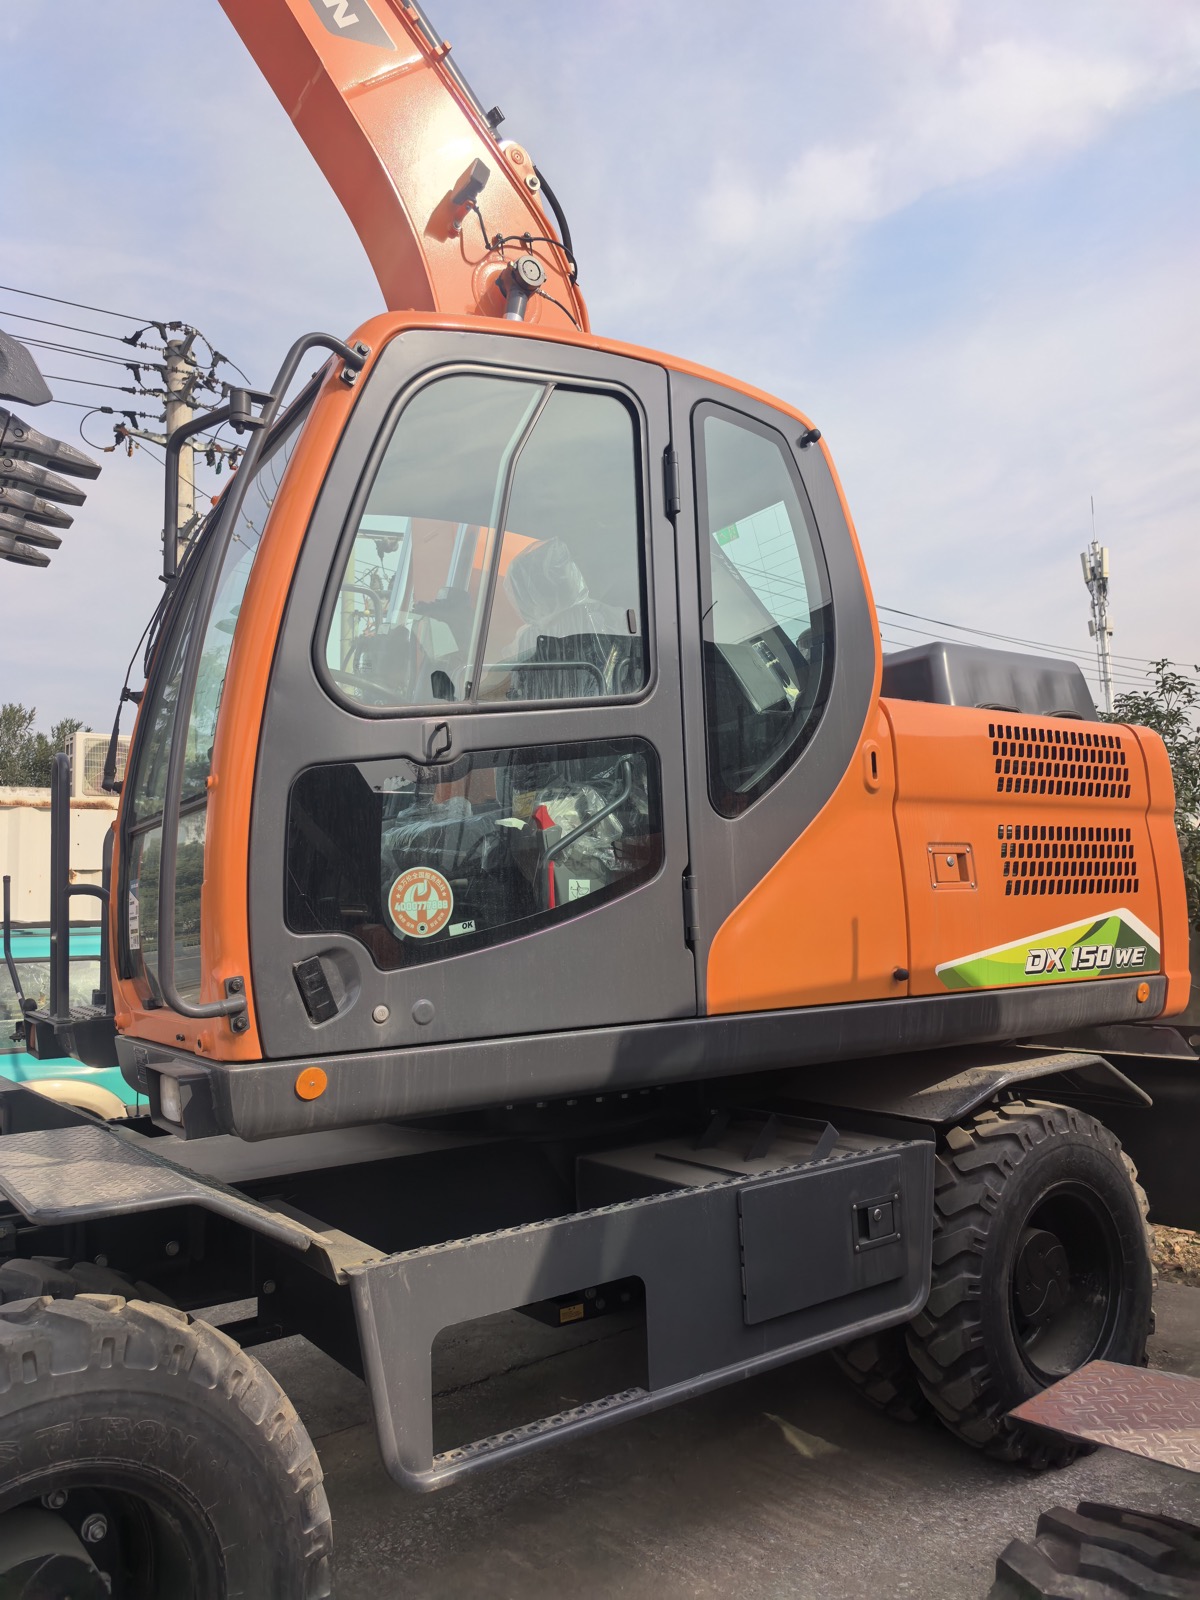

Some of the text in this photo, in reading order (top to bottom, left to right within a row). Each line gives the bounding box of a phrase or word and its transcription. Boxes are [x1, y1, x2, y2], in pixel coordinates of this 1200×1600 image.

[394, 900, 449, 912] 4000777888
[461, 920, 473, 929] OK
[1025, 944, 1147, 975] DX 150 WE
